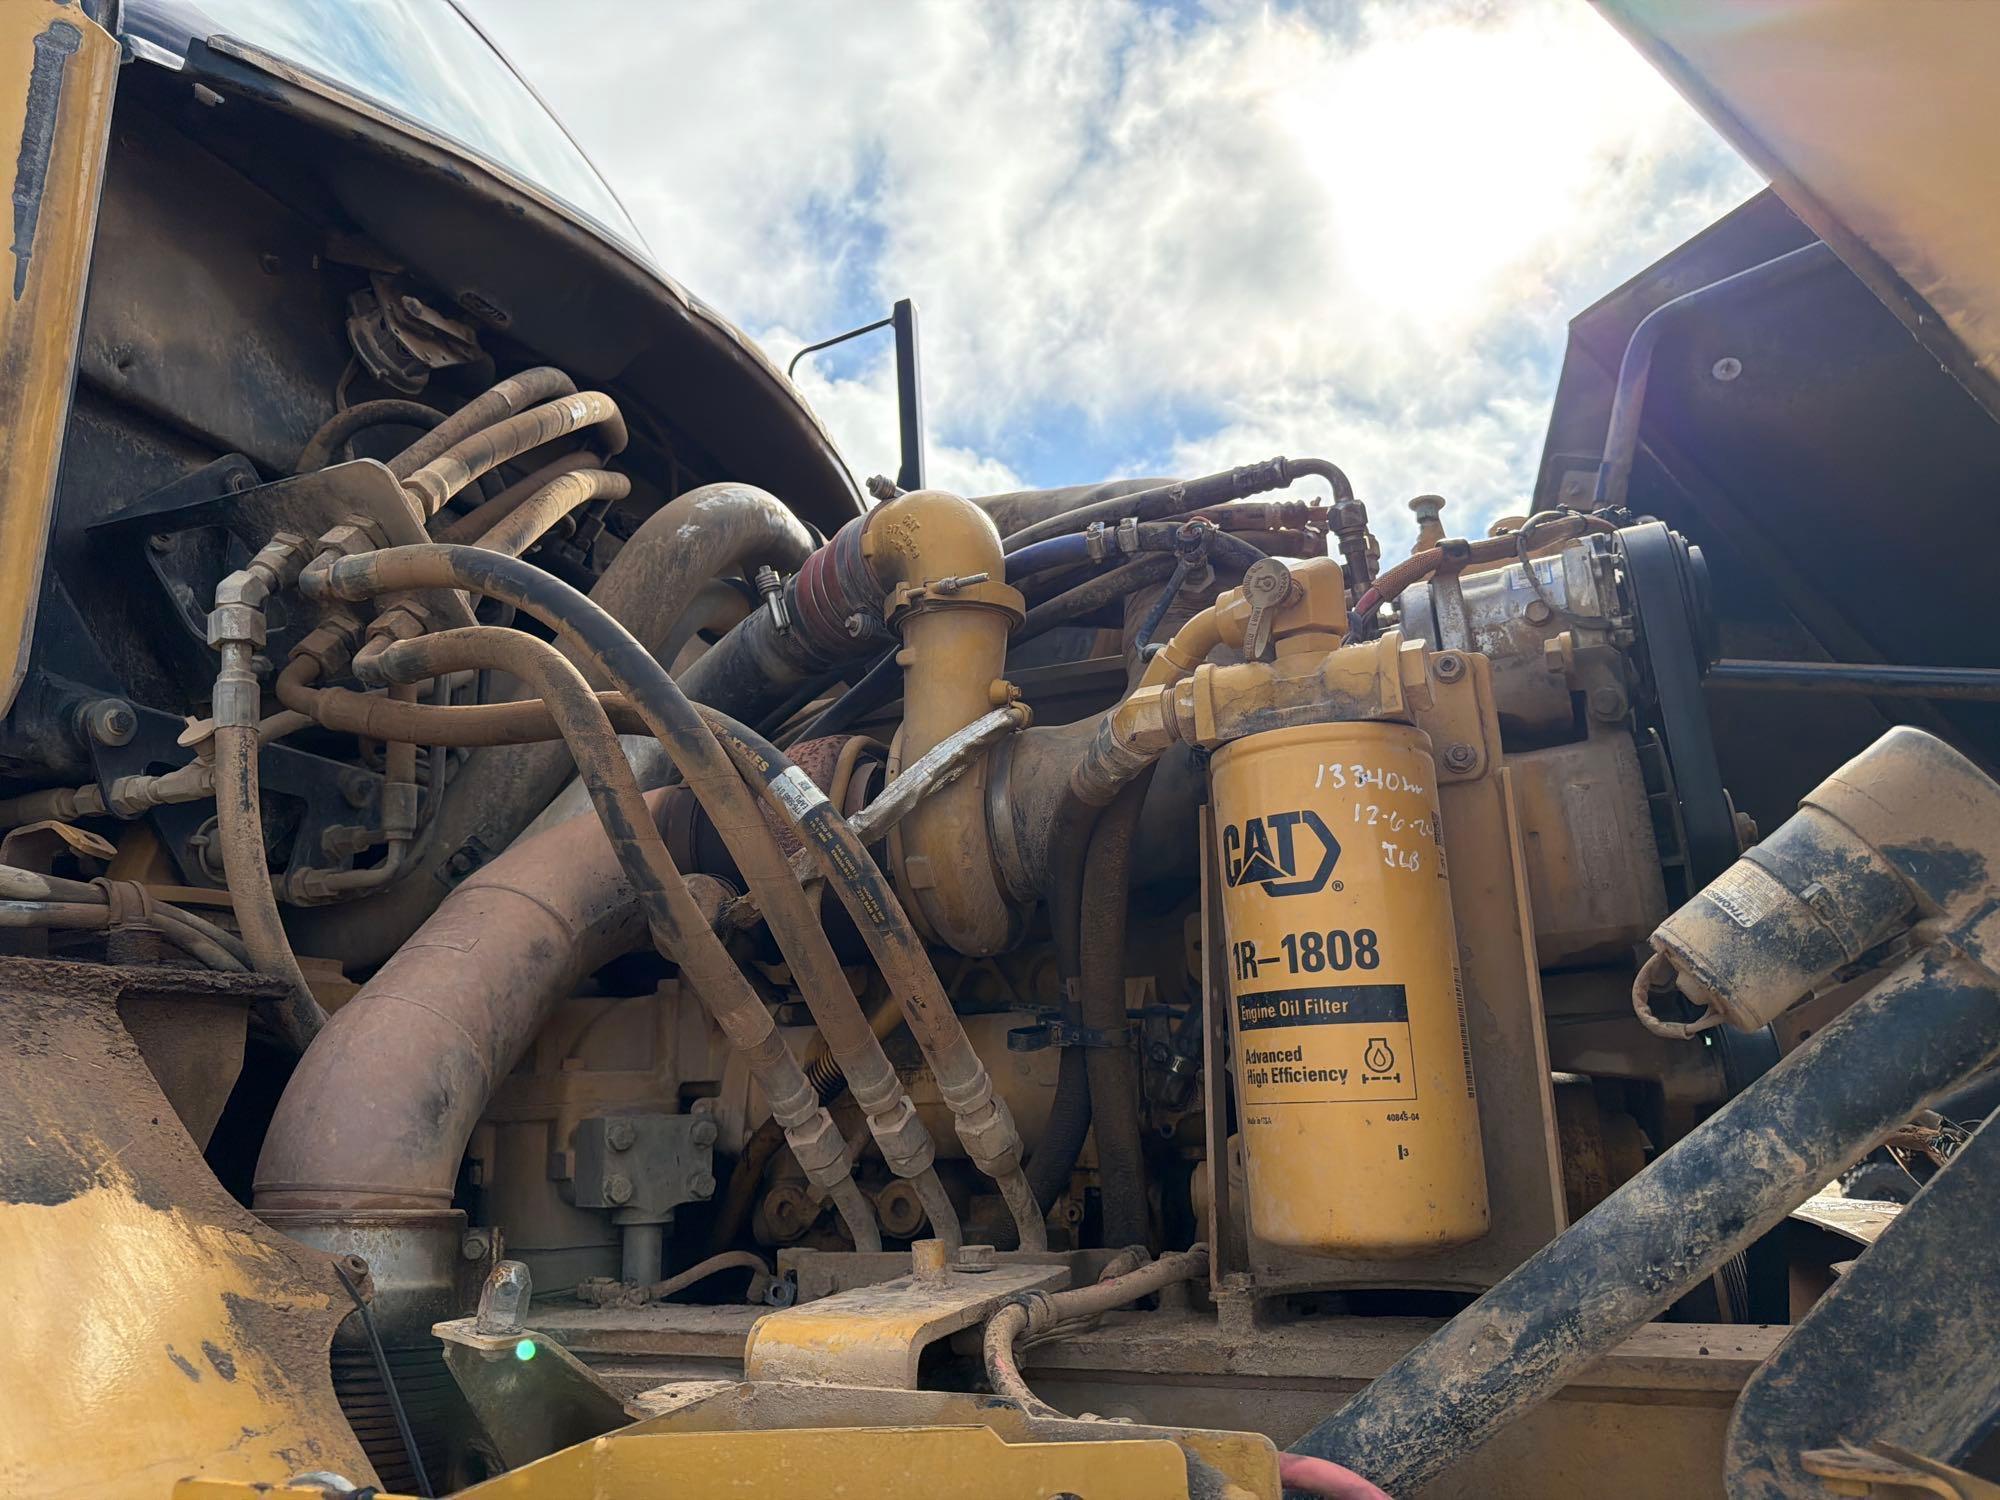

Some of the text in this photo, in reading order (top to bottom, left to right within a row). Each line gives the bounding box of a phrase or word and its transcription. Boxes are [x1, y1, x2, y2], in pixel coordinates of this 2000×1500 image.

[1223, 810, 1301, 888] CAT
[1232, 928, 1381, 981] 1R-1808
[1241, 998, 1349, 1023] Engine Oil Filter
[1245, 1045, 1303, 1065] Advanced
[1247, 1065, 1348, 1088] High Efficiency
